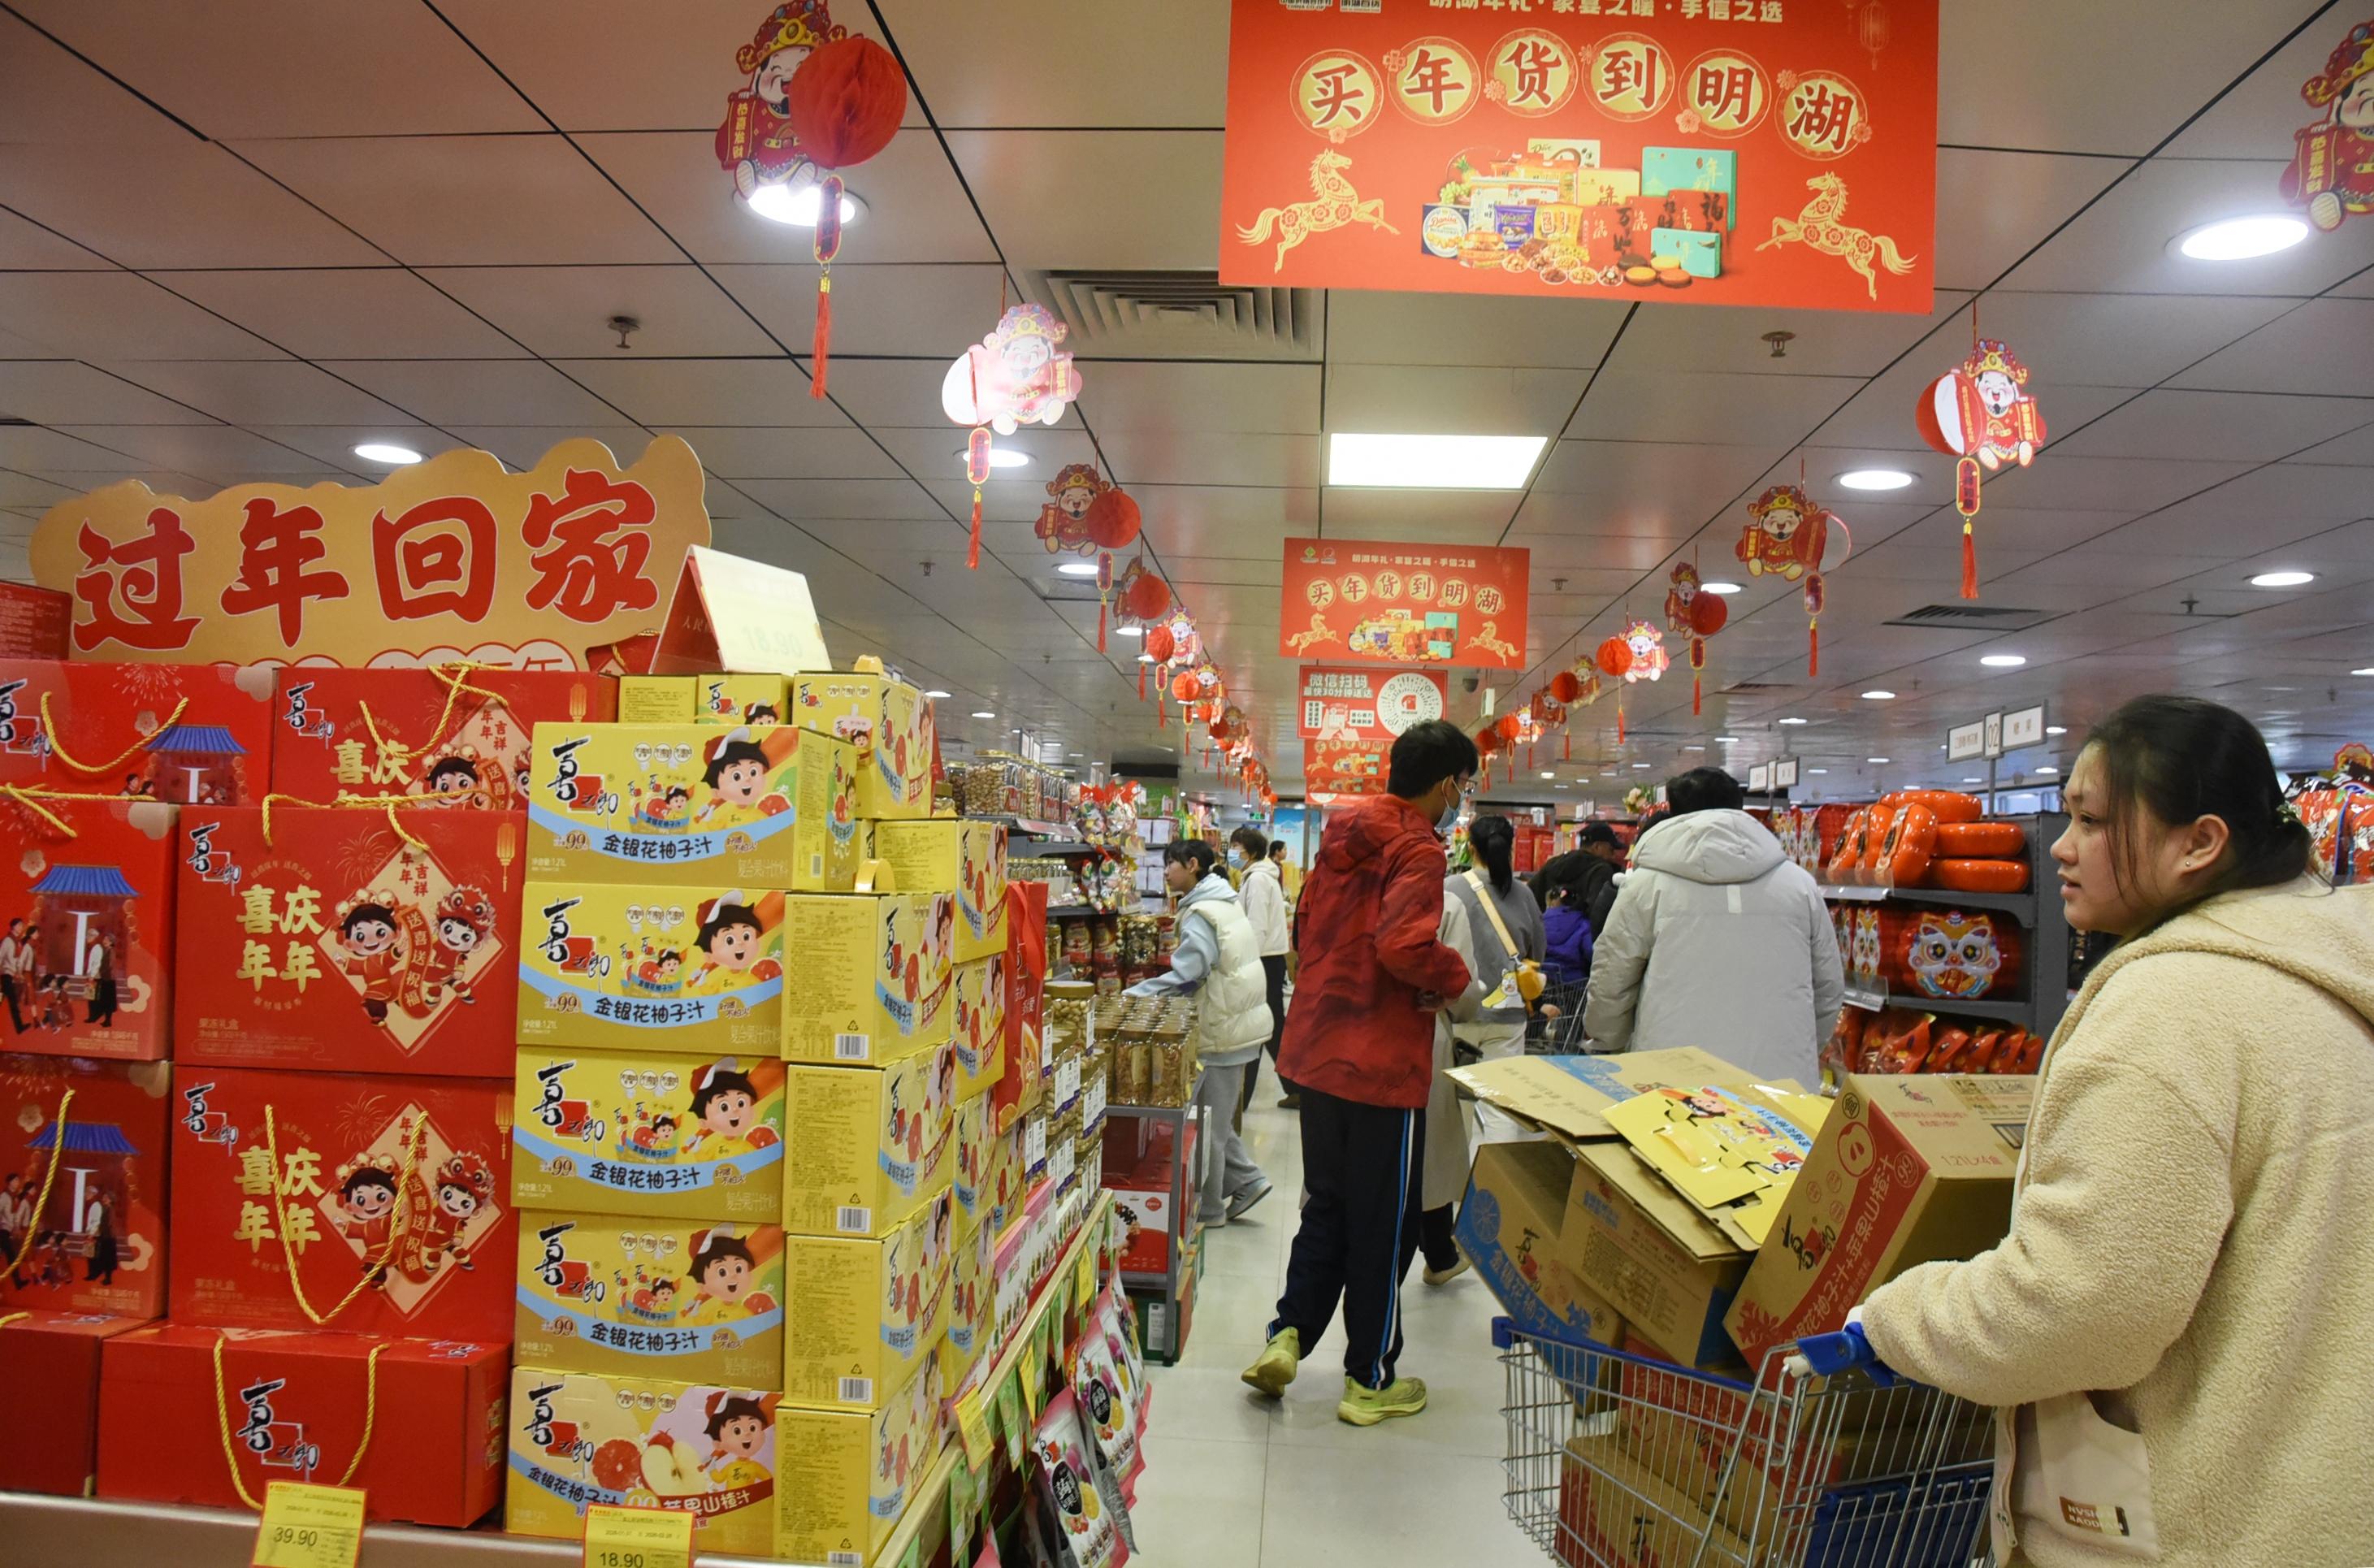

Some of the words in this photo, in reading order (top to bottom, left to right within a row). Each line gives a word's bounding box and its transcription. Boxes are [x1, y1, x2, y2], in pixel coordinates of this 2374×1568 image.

[1307, 42, 1856, 149] 买年货到明湖
[73, 466, 661, 652] 过年回家
[1310, 574, 1499, 613] 买年货到明湖
[1309, 674, 1368, 689] 微信扫码
[1987, 723, 1999, 748] 02
[329, 738, 412, 786] 喜庆
[565, 830, 587, 851] 99
[601, 833, 714, 860] 金银花柚子汁
[414, 864, 429, 897] 吉祥
[236, 883, 325, 936] 喜庆
[236, 938, 323, 994] 年年
[406, 912, 428, 1008] 送喜送祝福
[557, 994, 578, 1014] 99
[594, 996, 705, 1024] 金银花柚子汁
[234, 1146, 326, 1198] 喜庆
[552, 1157, 574, 1177] 99
[591, 1161, 701, 1189] 金银花柚子汁
[233, 1200, 323, 1256] 年年
[405, 1177, 427, 1272] 送喜送祝福
[552, 1317, 574, 1337] 99
[589, 1321, 700, 1352] 金银花柚子汁
[528, 1466, 621, 1505] 金银花柚子汁
[273, 1526, 318, 1547] 39.90
[599, 1552, 644, 1568] 18.90
